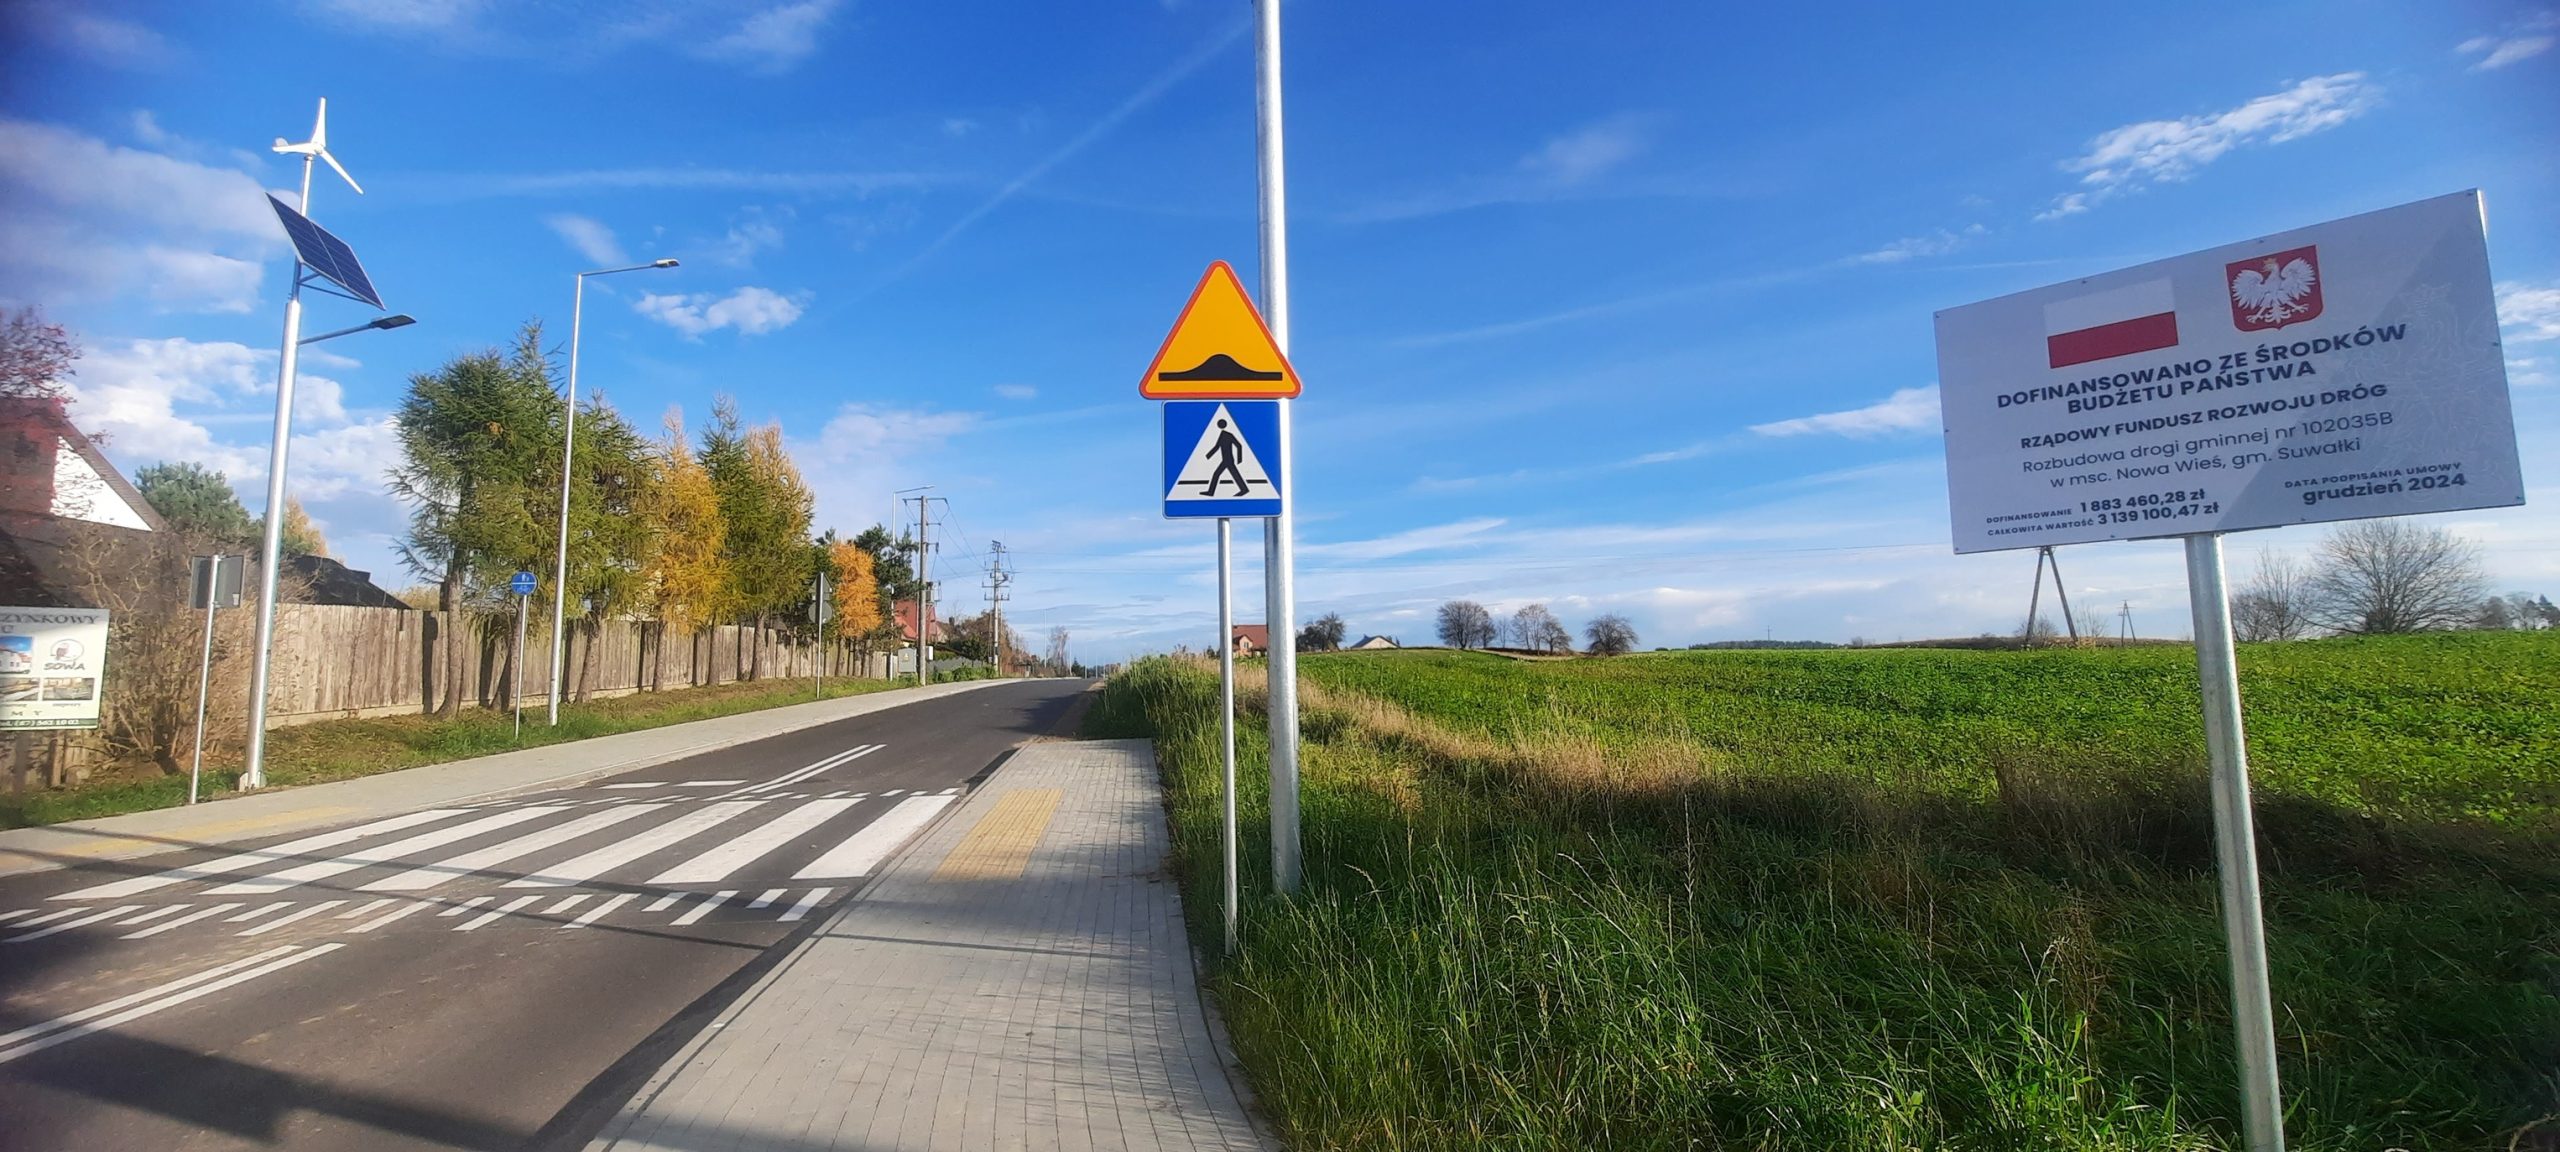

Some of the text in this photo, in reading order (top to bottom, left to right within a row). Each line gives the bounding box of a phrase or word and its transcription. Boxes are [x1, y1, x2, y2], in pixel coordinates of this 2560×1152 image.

[1997, 324, 2406, 408] DOFINANSOWANO ZE ŚRODKÓW
[2068, 360, 2316, 414] BUDŻETU PAŃSTWA
[2020, 383, 2388, 449] RZĄDOWY FUNDUSZ ROZWOJU DRÓG
[2023, 411, 2393, 473] Rozbudowa drogi gminnej nr 102035B
[2050, 437, 2361, 488] w msc. Nowa Wieś, gm. Suwałki
[2284, 462, 2462, 488] DATA PODPISANIA UMOWY
[2302, 473, 2467, 506] grudzień 2024
[1986, 488, 2206, 524] DOFINANSOWANIE 1 883 460,28 zł
[1987, 501, 2219, 536] CAŁKOWITA WARTOŚĆ 3 139 100,47 zł
[43, 662, 85, 671] SOWA
